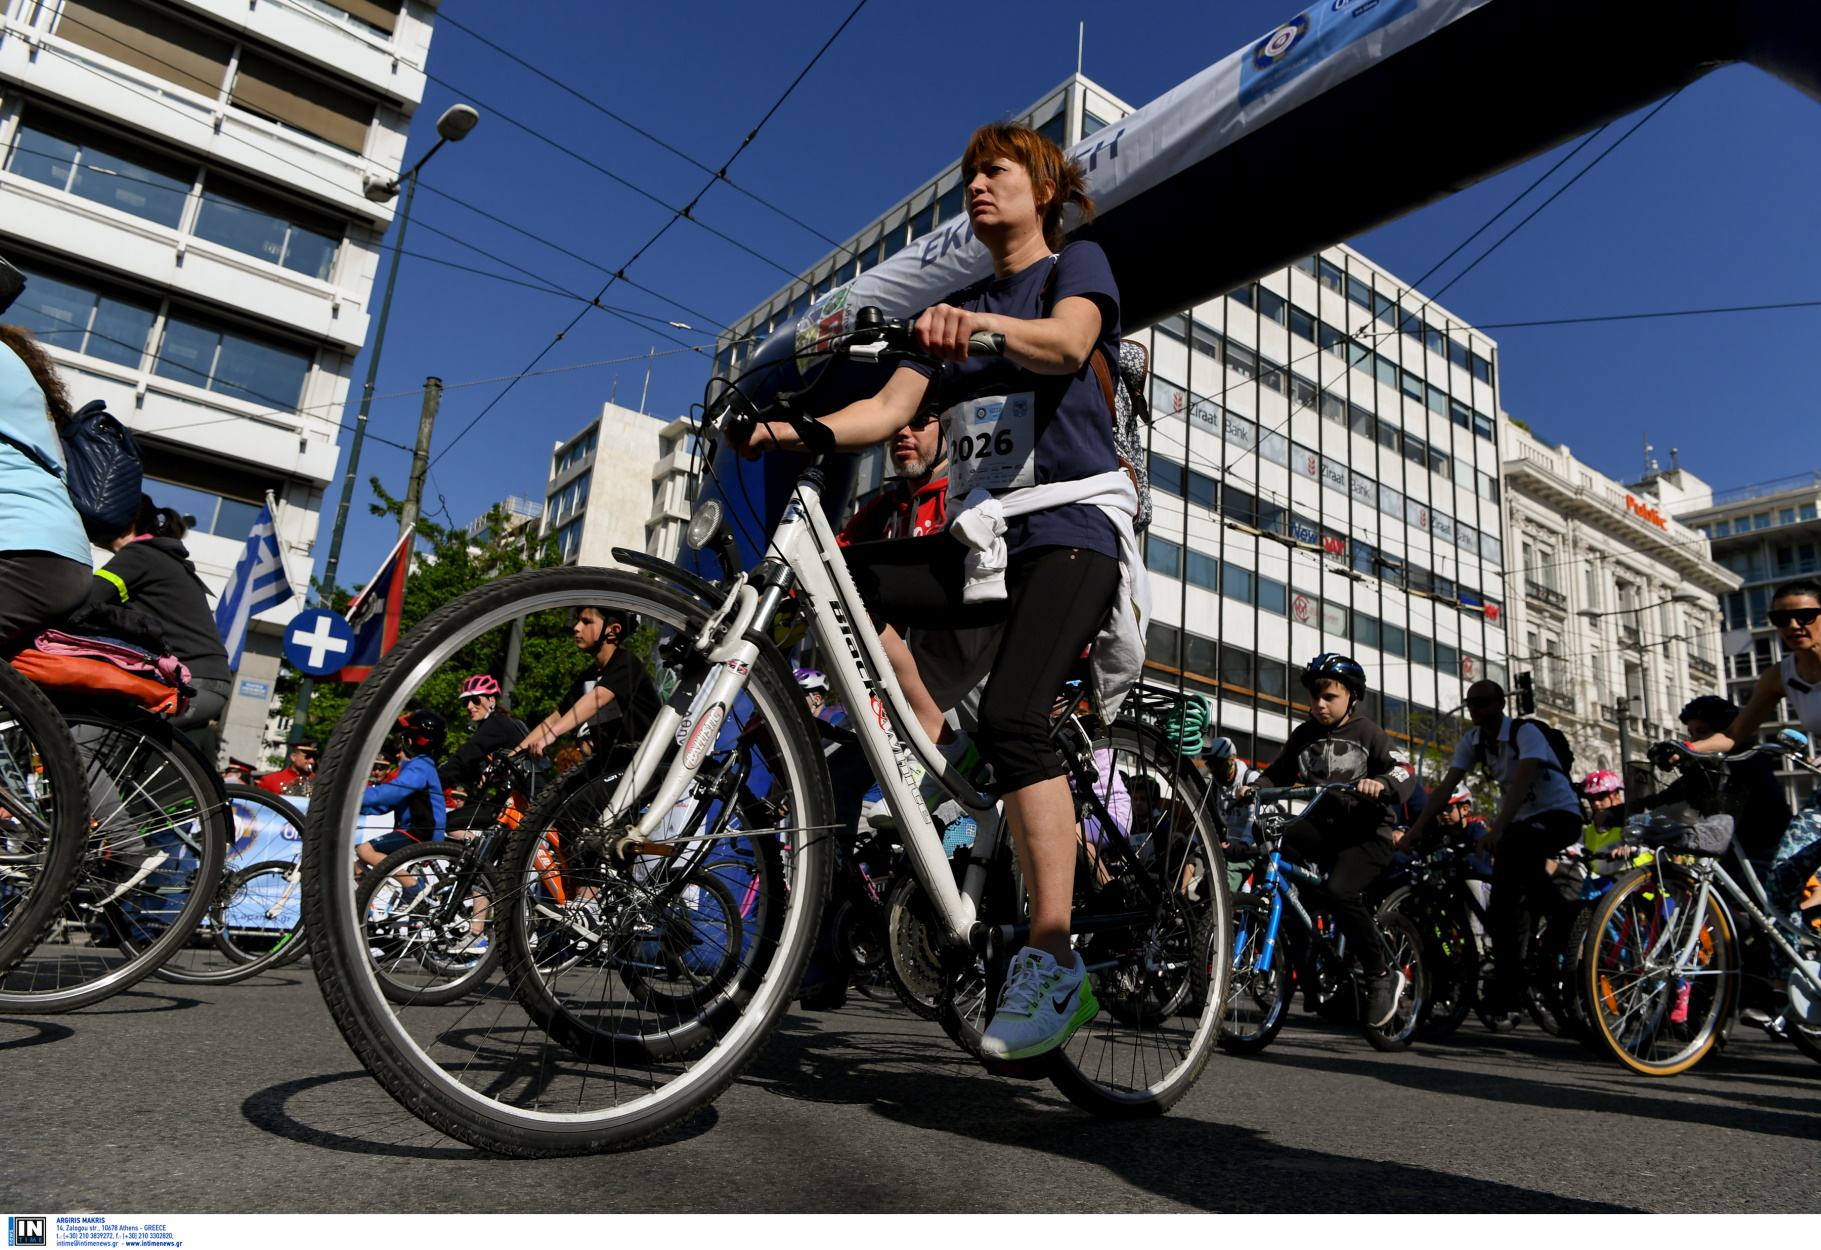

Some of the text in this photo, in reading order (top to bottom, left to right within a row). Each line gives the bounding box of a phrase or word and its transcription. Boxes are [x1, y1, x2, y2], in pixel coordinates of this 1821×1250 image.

[1189, 401, 1249, 442] Ziraat Bank
[1321, 464, 1371, 499] Ziraat Bank
[1625, 494, 1669, 532] Public
[1291, 520, 1318, 545] New
[685, 704, 722, 768] BALLISTIC
[1028, 953, 1044, 963] NIKE
